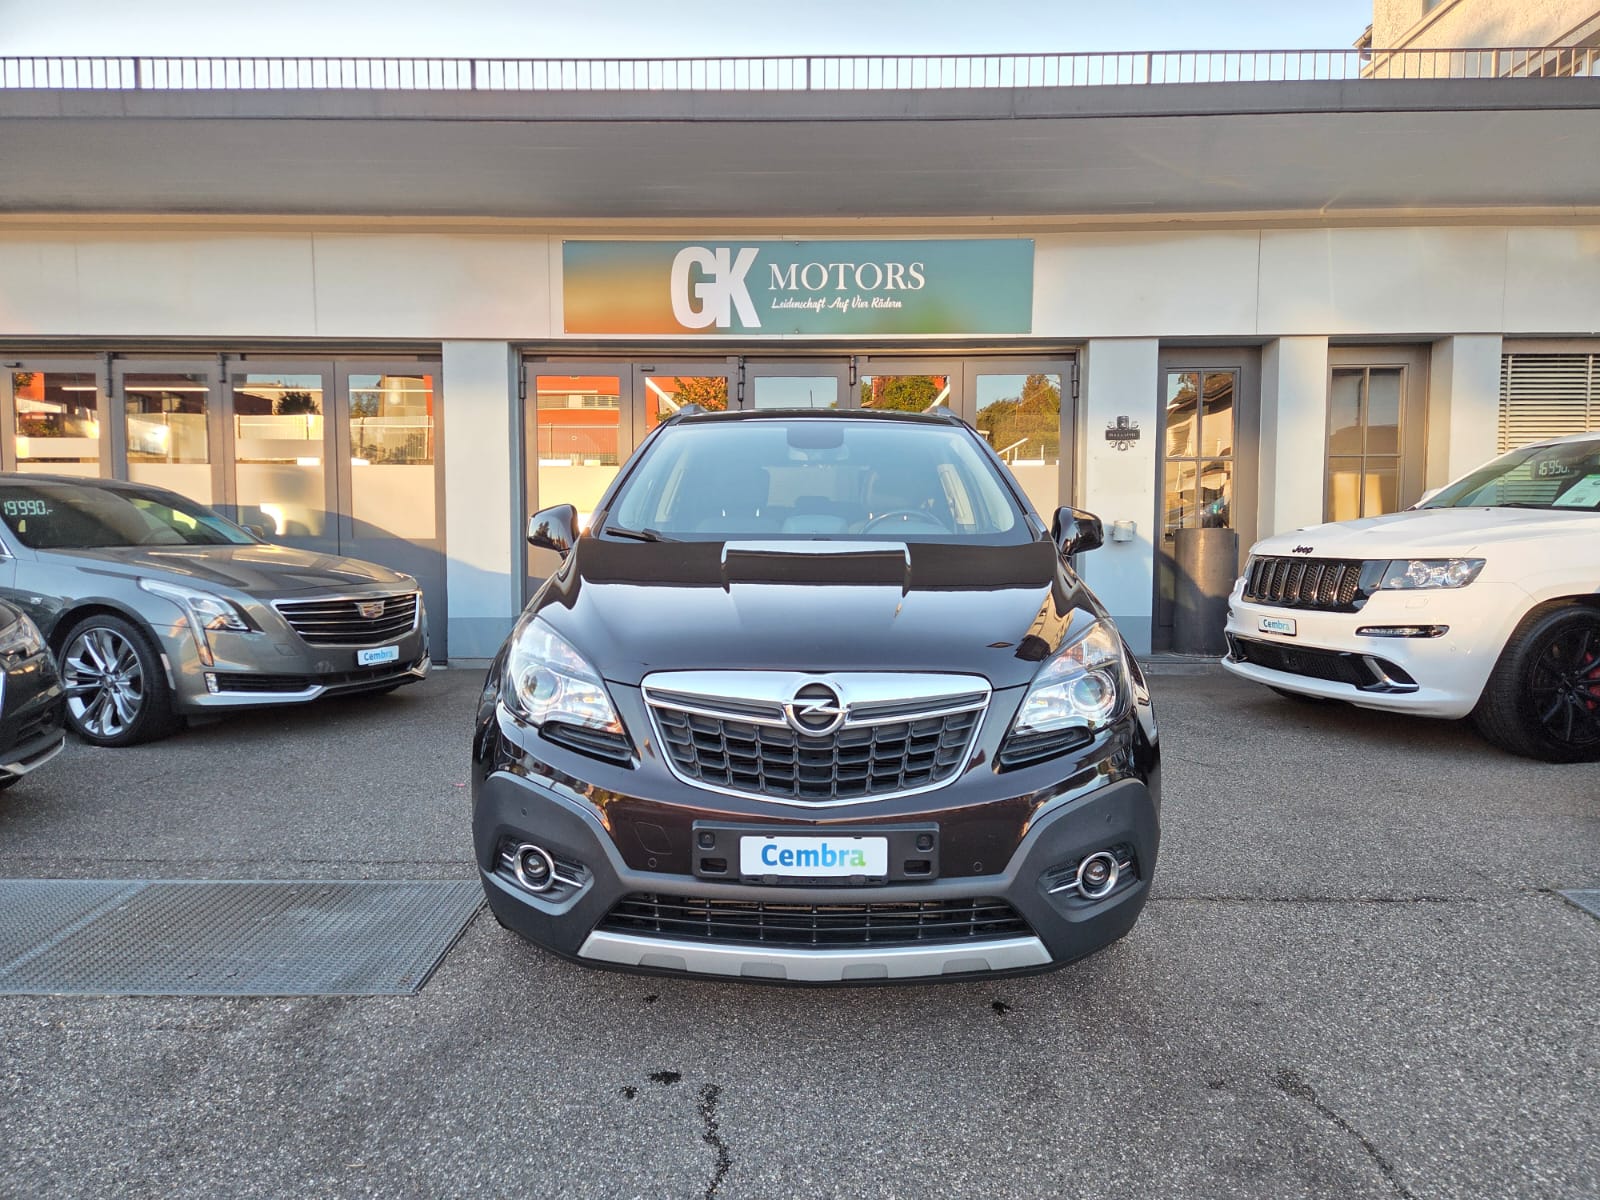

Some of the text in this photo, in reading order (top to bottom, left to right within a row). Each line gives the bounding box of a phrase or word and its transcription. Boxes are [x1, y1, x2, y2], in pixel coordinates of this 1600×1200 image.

[670, 246, 926, 329] GK MOTORS
[771, 295, 902, 312] Leidenschaft Auf Vier Rädern
[1292, 545, 1313, 555] Jeep
[1263, 619, 1291, 631] Cembra
[363, 649, 393, 662] Cembra
[761, 843, 866, 868] Cembra
